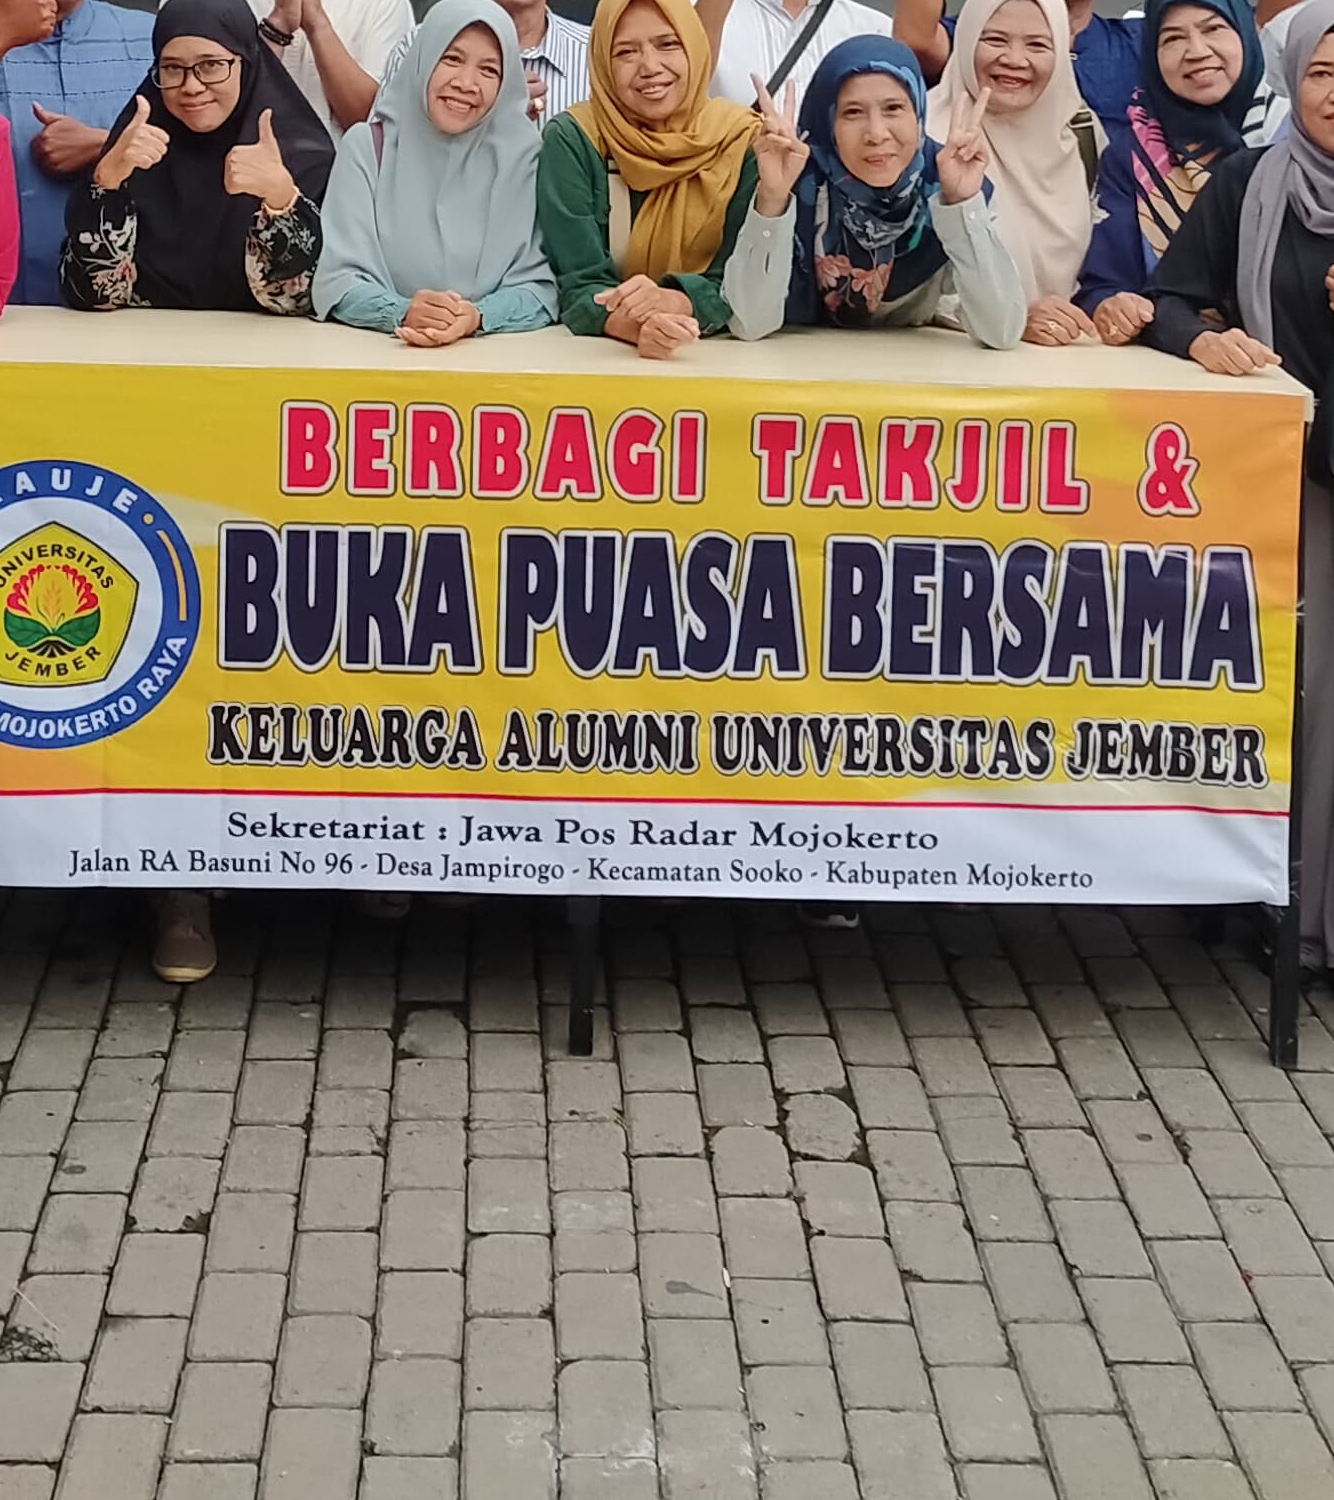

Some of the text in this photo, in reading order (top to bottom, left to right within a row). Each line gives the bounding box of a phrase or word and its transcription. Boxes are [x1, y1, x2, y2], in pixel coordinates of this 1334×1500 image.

[282, 400, 1201, 516] BERBAGI TAKJIL &
[217, 522, 1265, 692] BUKA PUASA BERSAMA
[5, 646, 101, 678] JEMBER
[136, 637, 188, 699] RAYA
[207, 702, 1268, 789] KELUARGA ALUMNI UNIVERSITAS JEMBER
[227, 812, 425, 841] Sekretariat
[459, 816, 542, 847] Jawa
[556, 819, 615, 846] Pos
[629, 819, 737, 847] Radar
[749, 821, 939, 852] Mojokerto
[68, 849, 130, 877] Jalan
[139, 850, 178, 873] RA
[189, 850, 271, 874] Basuni
[280, 852, 316, 875] No
[324, 852, 353, 876] 96
[376, 853, 433, 877] Desa
[440, 854, 565, 883] Jampirogo
[587, 858, 721, 883] Kecamatan
[730, 859, 803, 884] Sooko
[826, 860, 958, 890] Kabupaten
[966, 863, 1094, 891] Mojokerto
